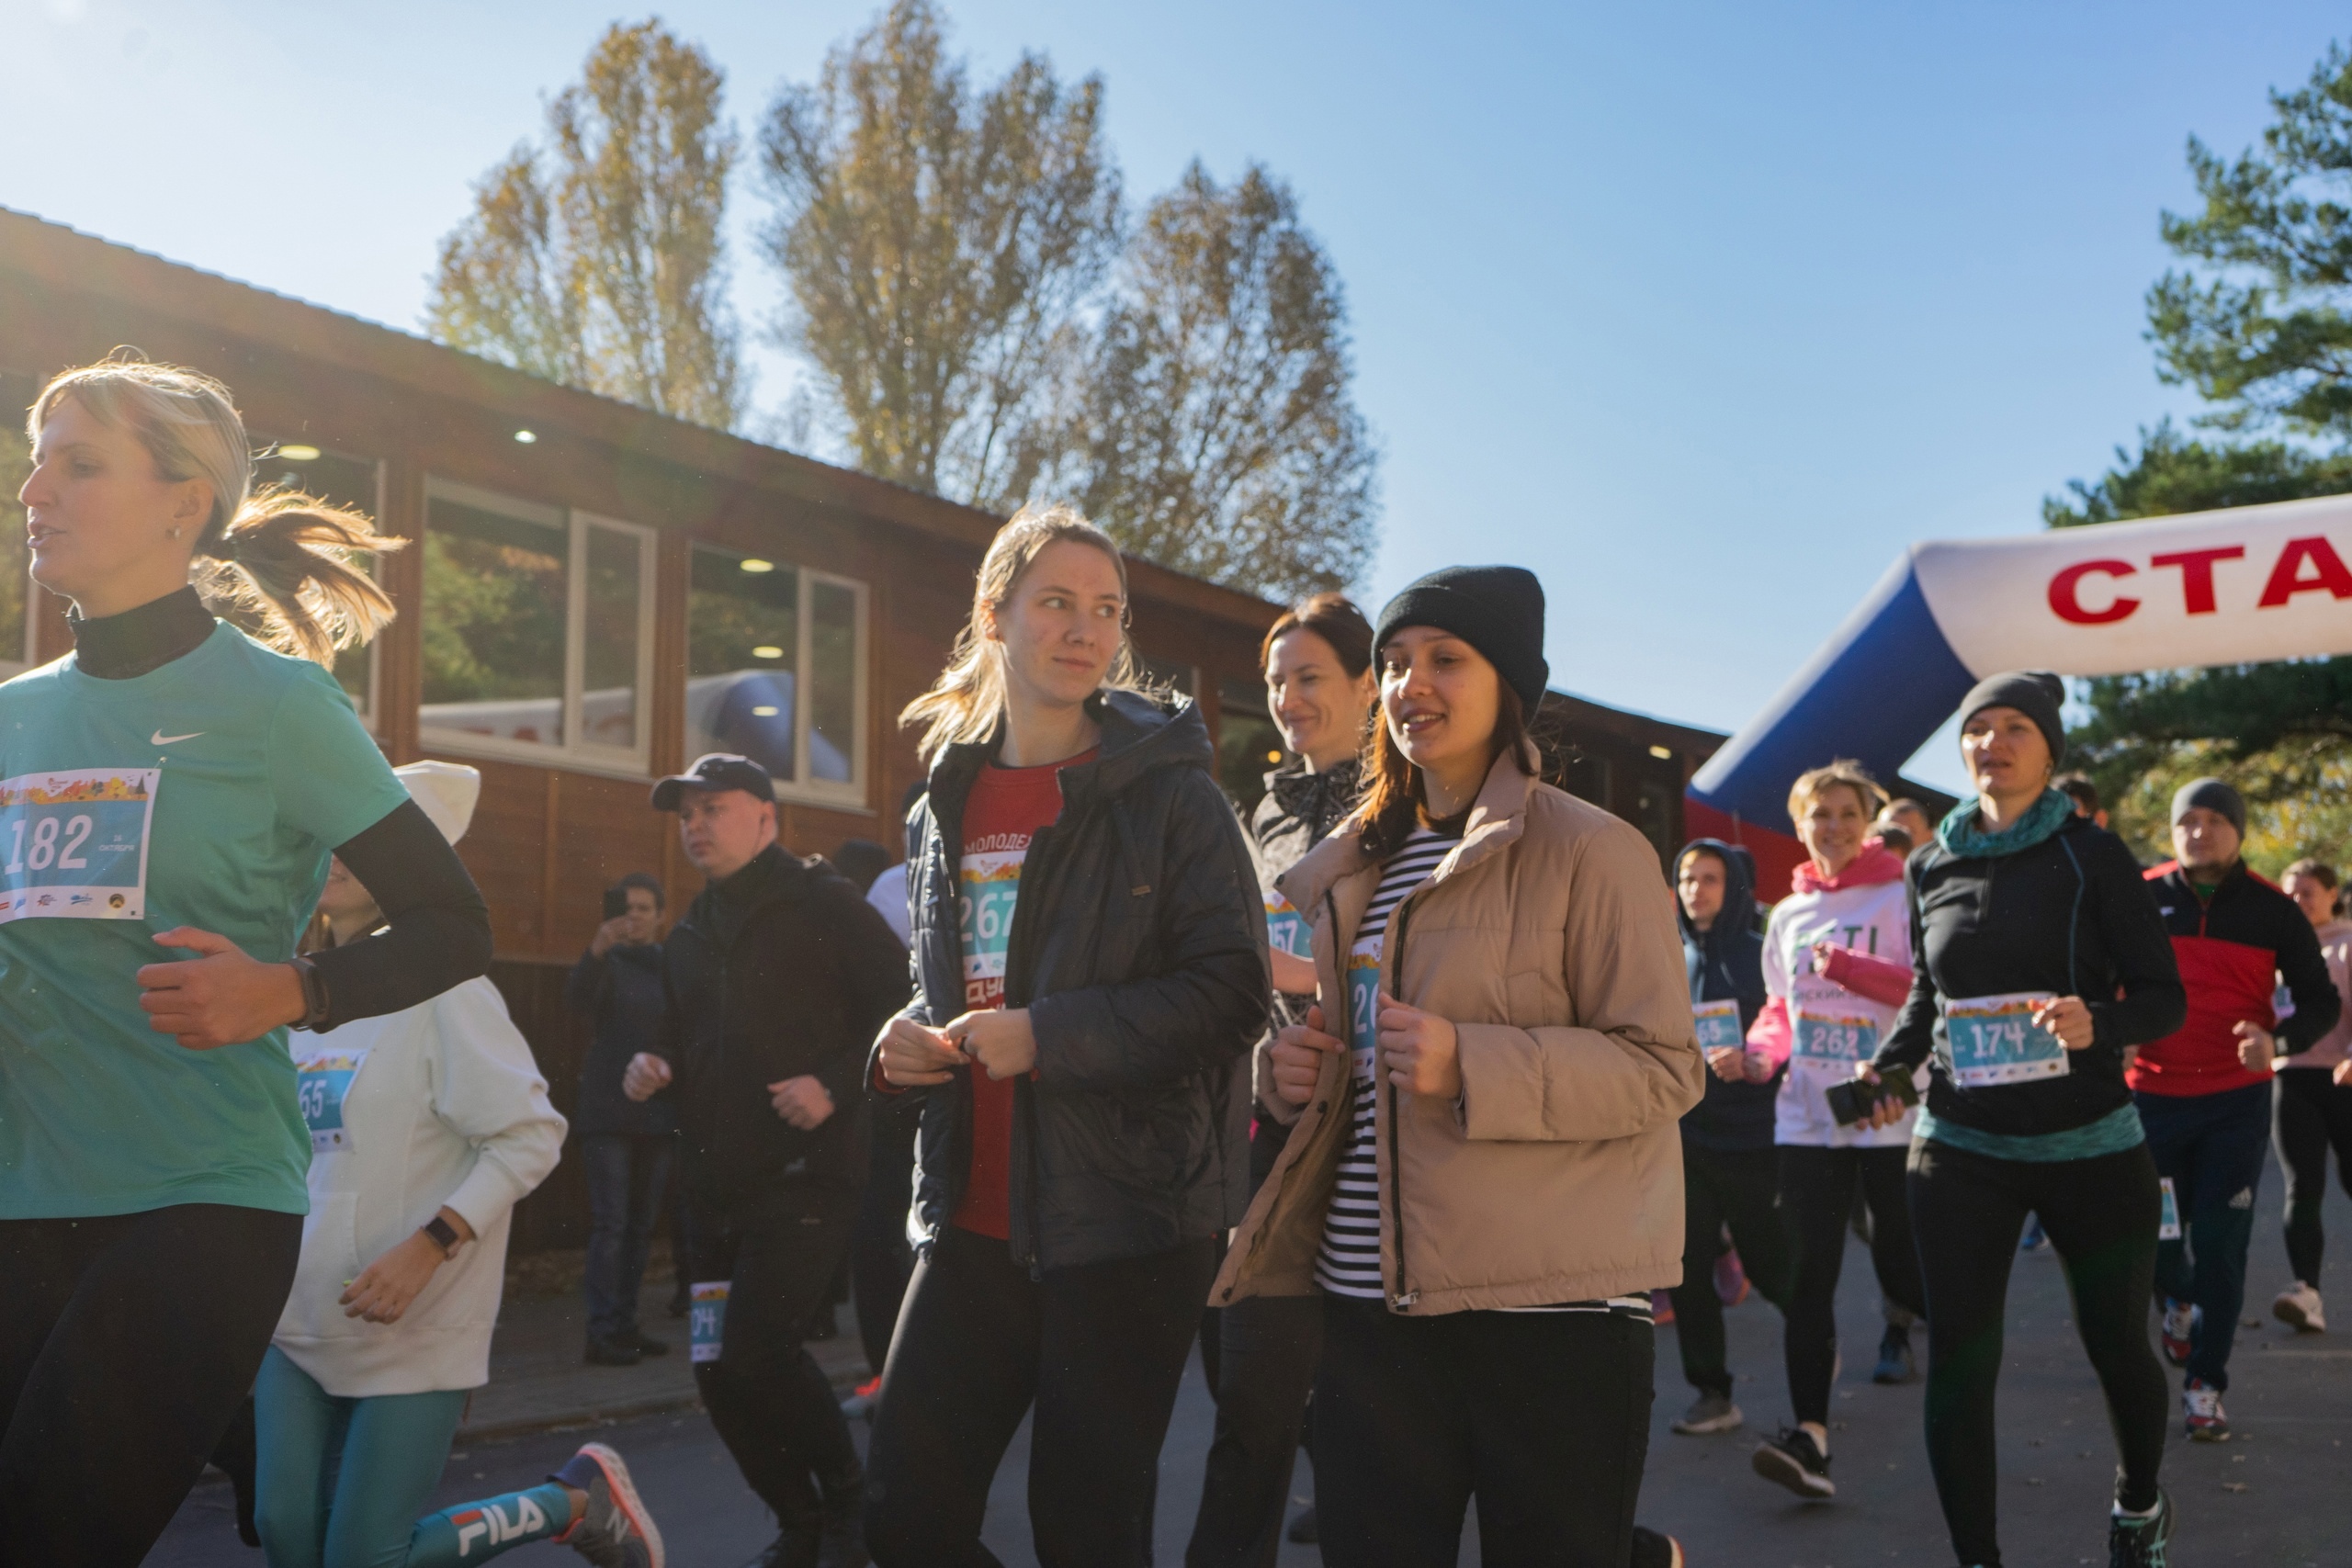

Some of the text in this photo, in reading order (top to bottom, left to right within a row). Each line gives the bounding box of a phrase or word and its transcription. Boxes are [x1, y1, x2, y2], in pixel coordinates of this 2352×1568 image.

[2047, 535, 2352, 627] СТА
[4, 814, 93, 875] 182
[1970, 1021, 2026, 1058] 174
[451, 1496, 546, 1557] FILA
